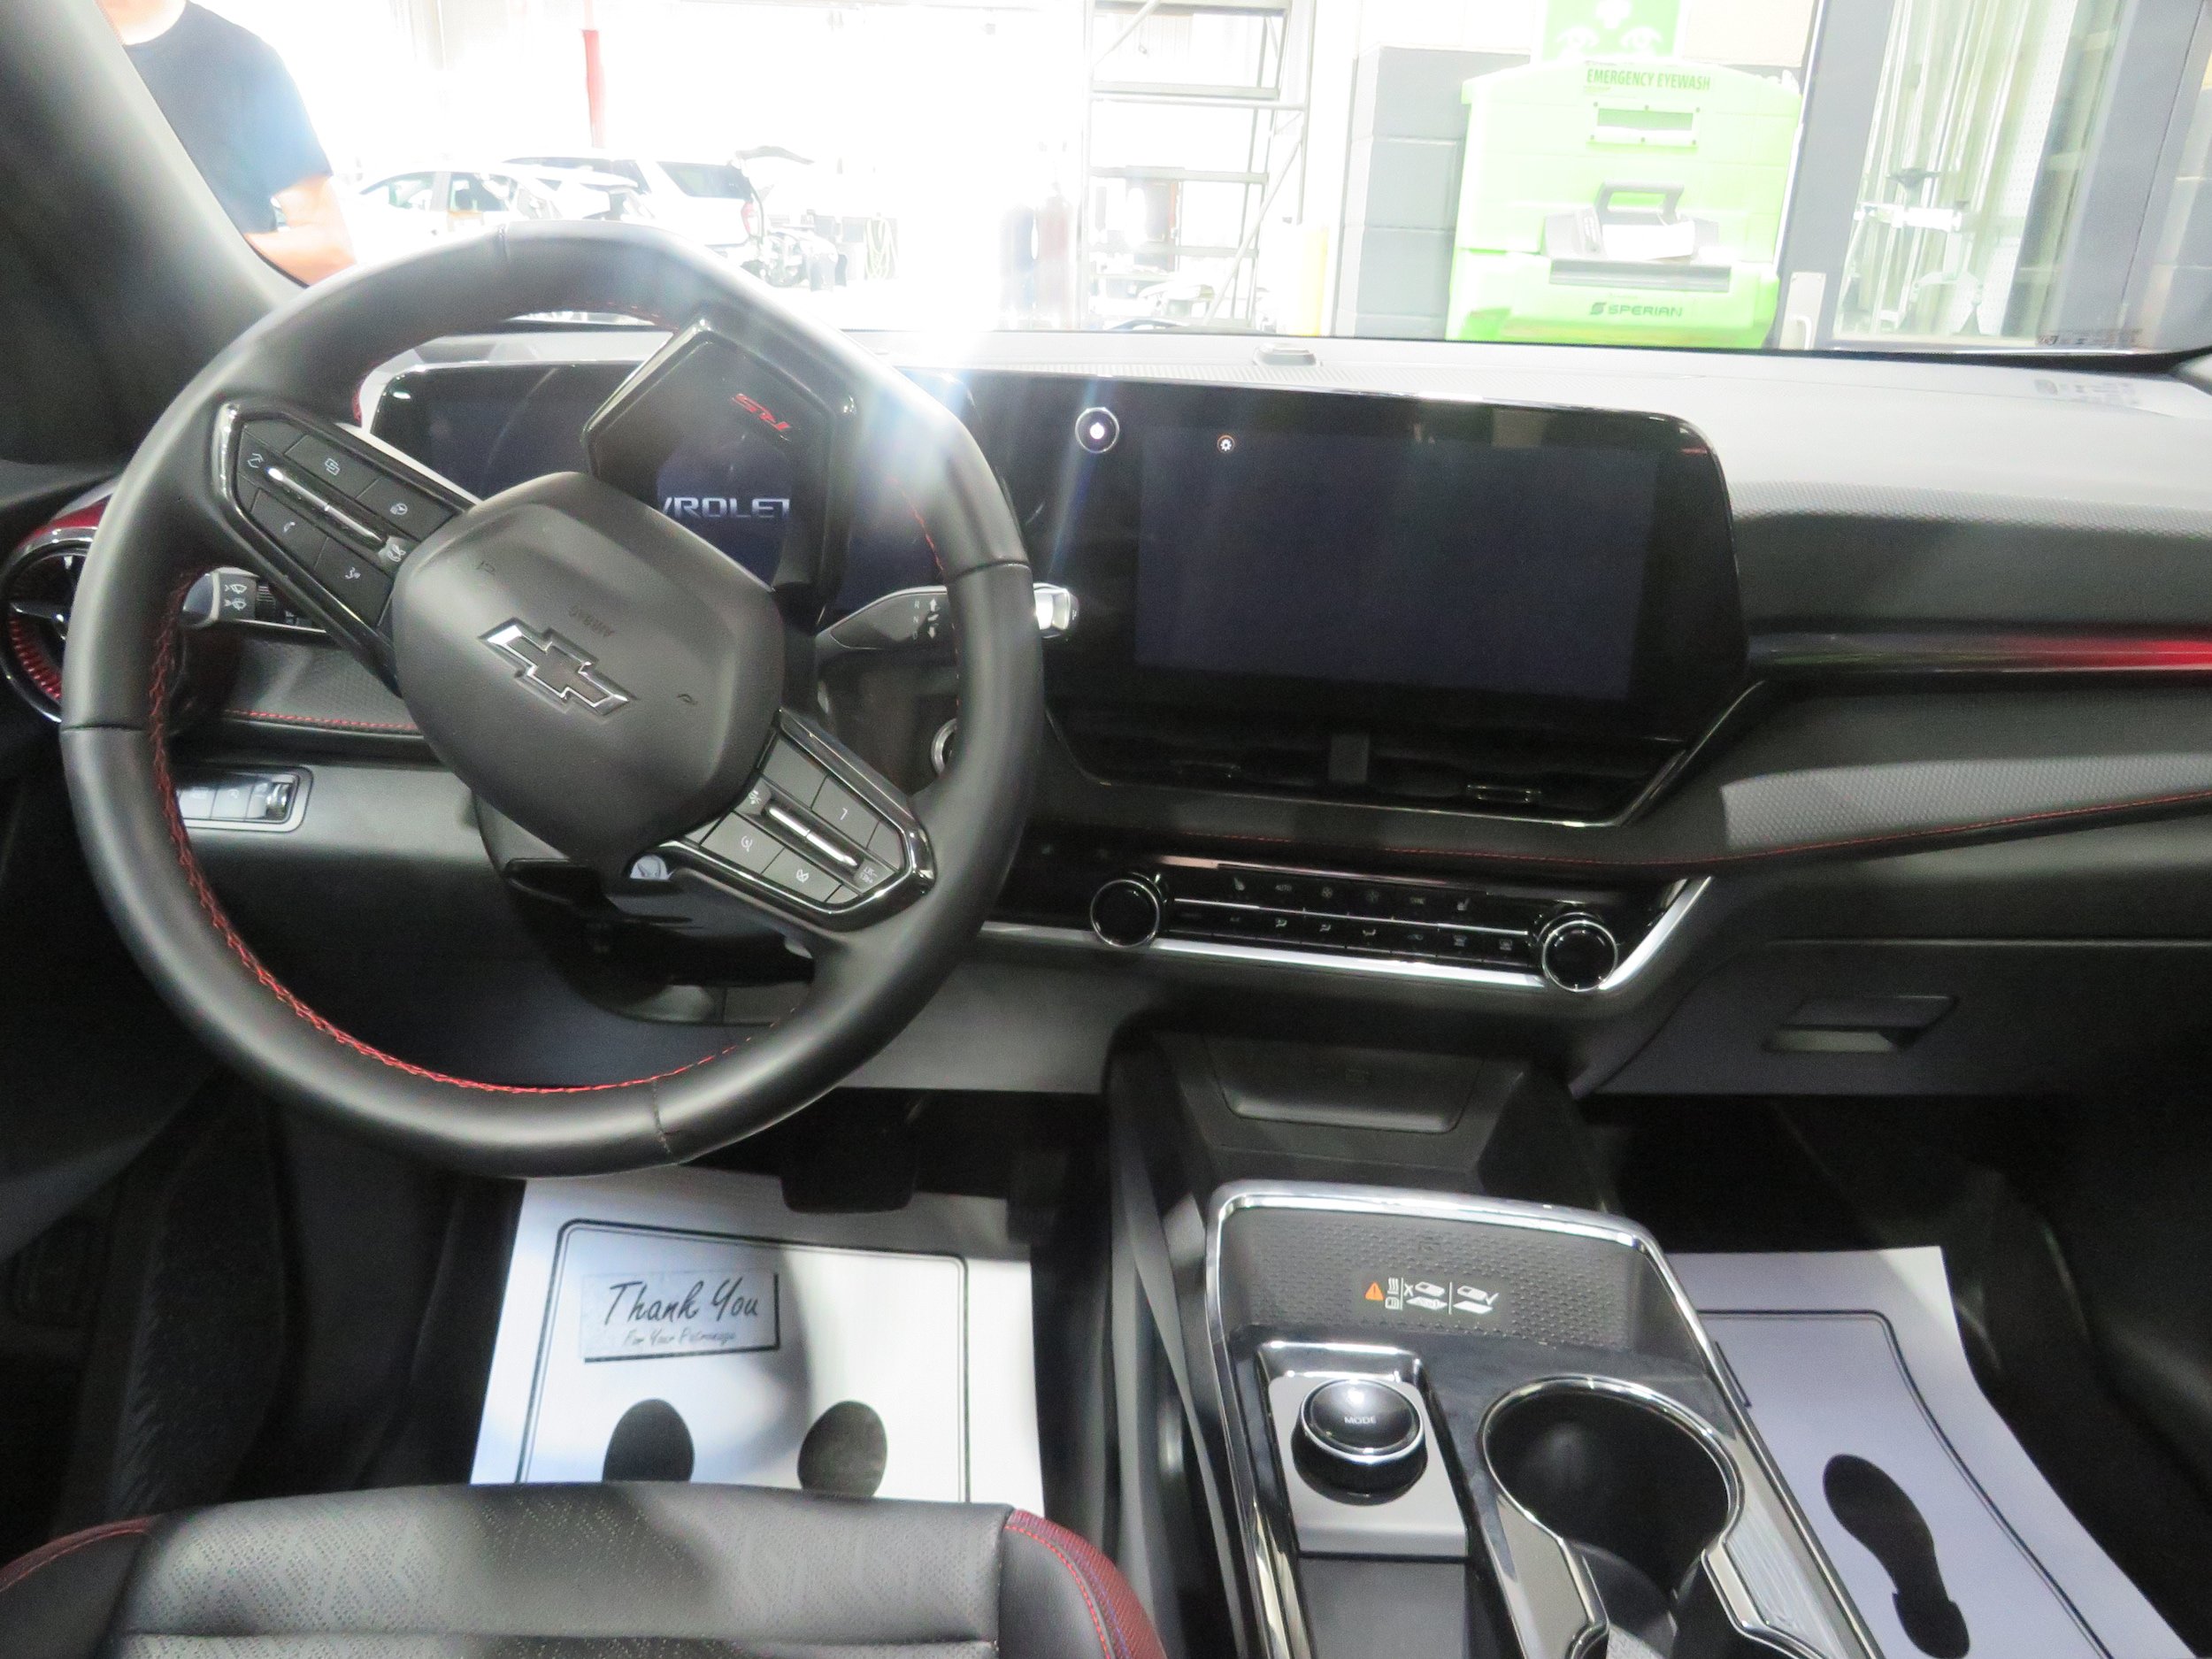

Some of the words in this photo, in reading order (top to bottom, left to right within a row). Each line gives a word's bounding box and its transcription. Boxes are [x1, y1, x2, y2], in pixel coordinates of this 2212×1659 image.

[1586, 68, 1655, 87] EMERGENCY
[1656, 72, 1711, 91] EYEWASH
[1608, 303, 1683, 318] SPERIAN
[604, 1280, 705, 1325] Thank
[711, 1277, 759, 1322] You
[1343, 1415, 1378, 1425] MODE
